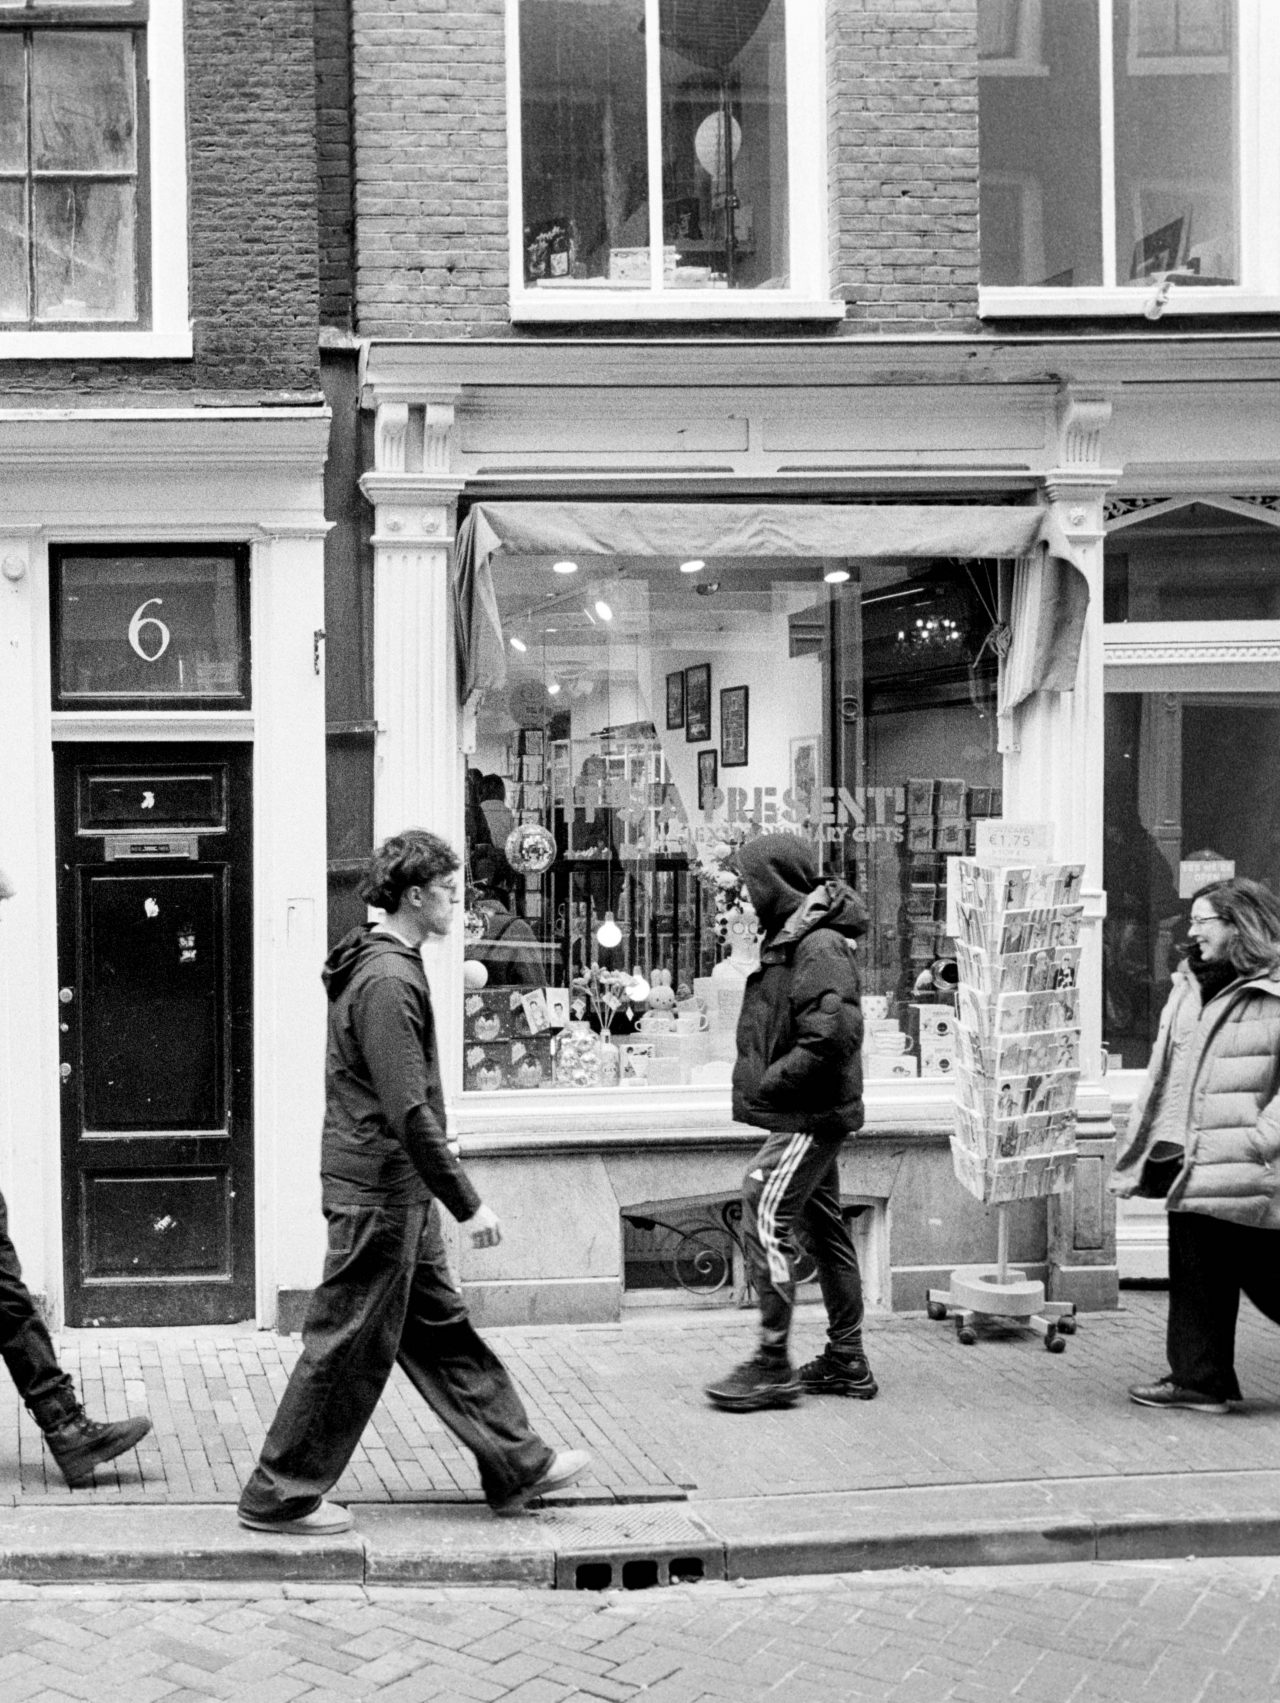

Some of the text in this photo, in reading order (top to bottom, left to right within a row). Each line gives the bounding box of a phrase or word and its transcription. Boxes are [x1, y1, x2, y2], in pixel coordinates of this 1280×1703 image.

[128, 597, 170, 661] 6
[657, 783, 690, 823] A
[702, 786, 906, 825] PRESENT!
[853, 826, 905, 842] GIFTS
